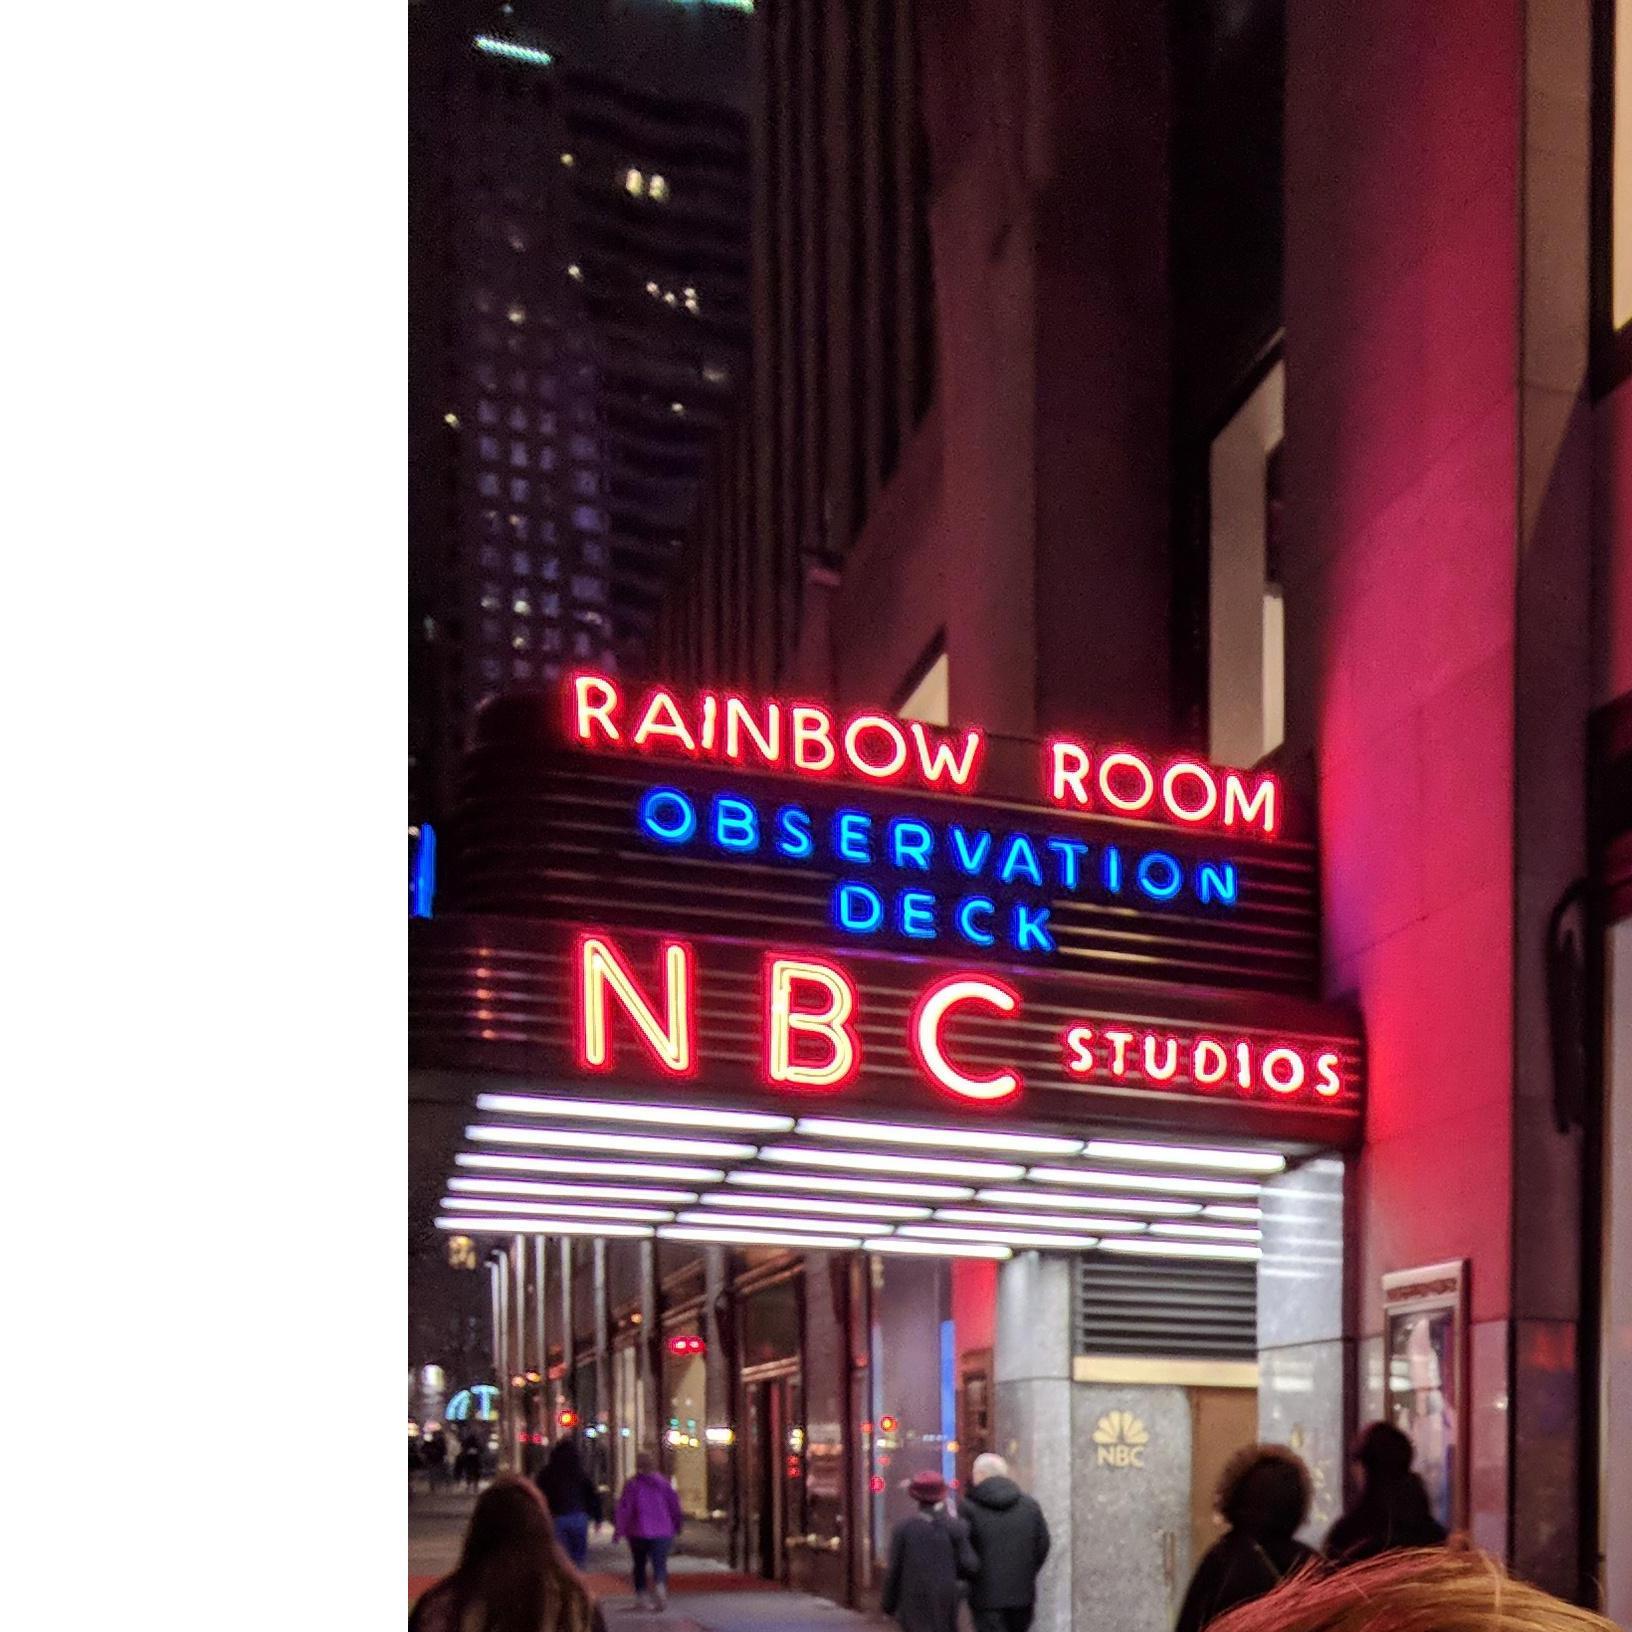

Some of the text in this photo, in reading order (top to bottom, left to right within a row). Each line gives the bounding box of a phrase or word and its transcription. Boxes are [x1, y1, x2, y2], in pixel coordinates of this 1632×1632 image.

[572, 671, 1279, 834] RAINBOW ROOM
[643, 788, 1239, 902] OBSERVATION
[838, 885, 1054, 952] DECK
[577, 936, 1343, 1102] NBC STUDIOS
[1096, 1444, 1144, 1468] NBC
